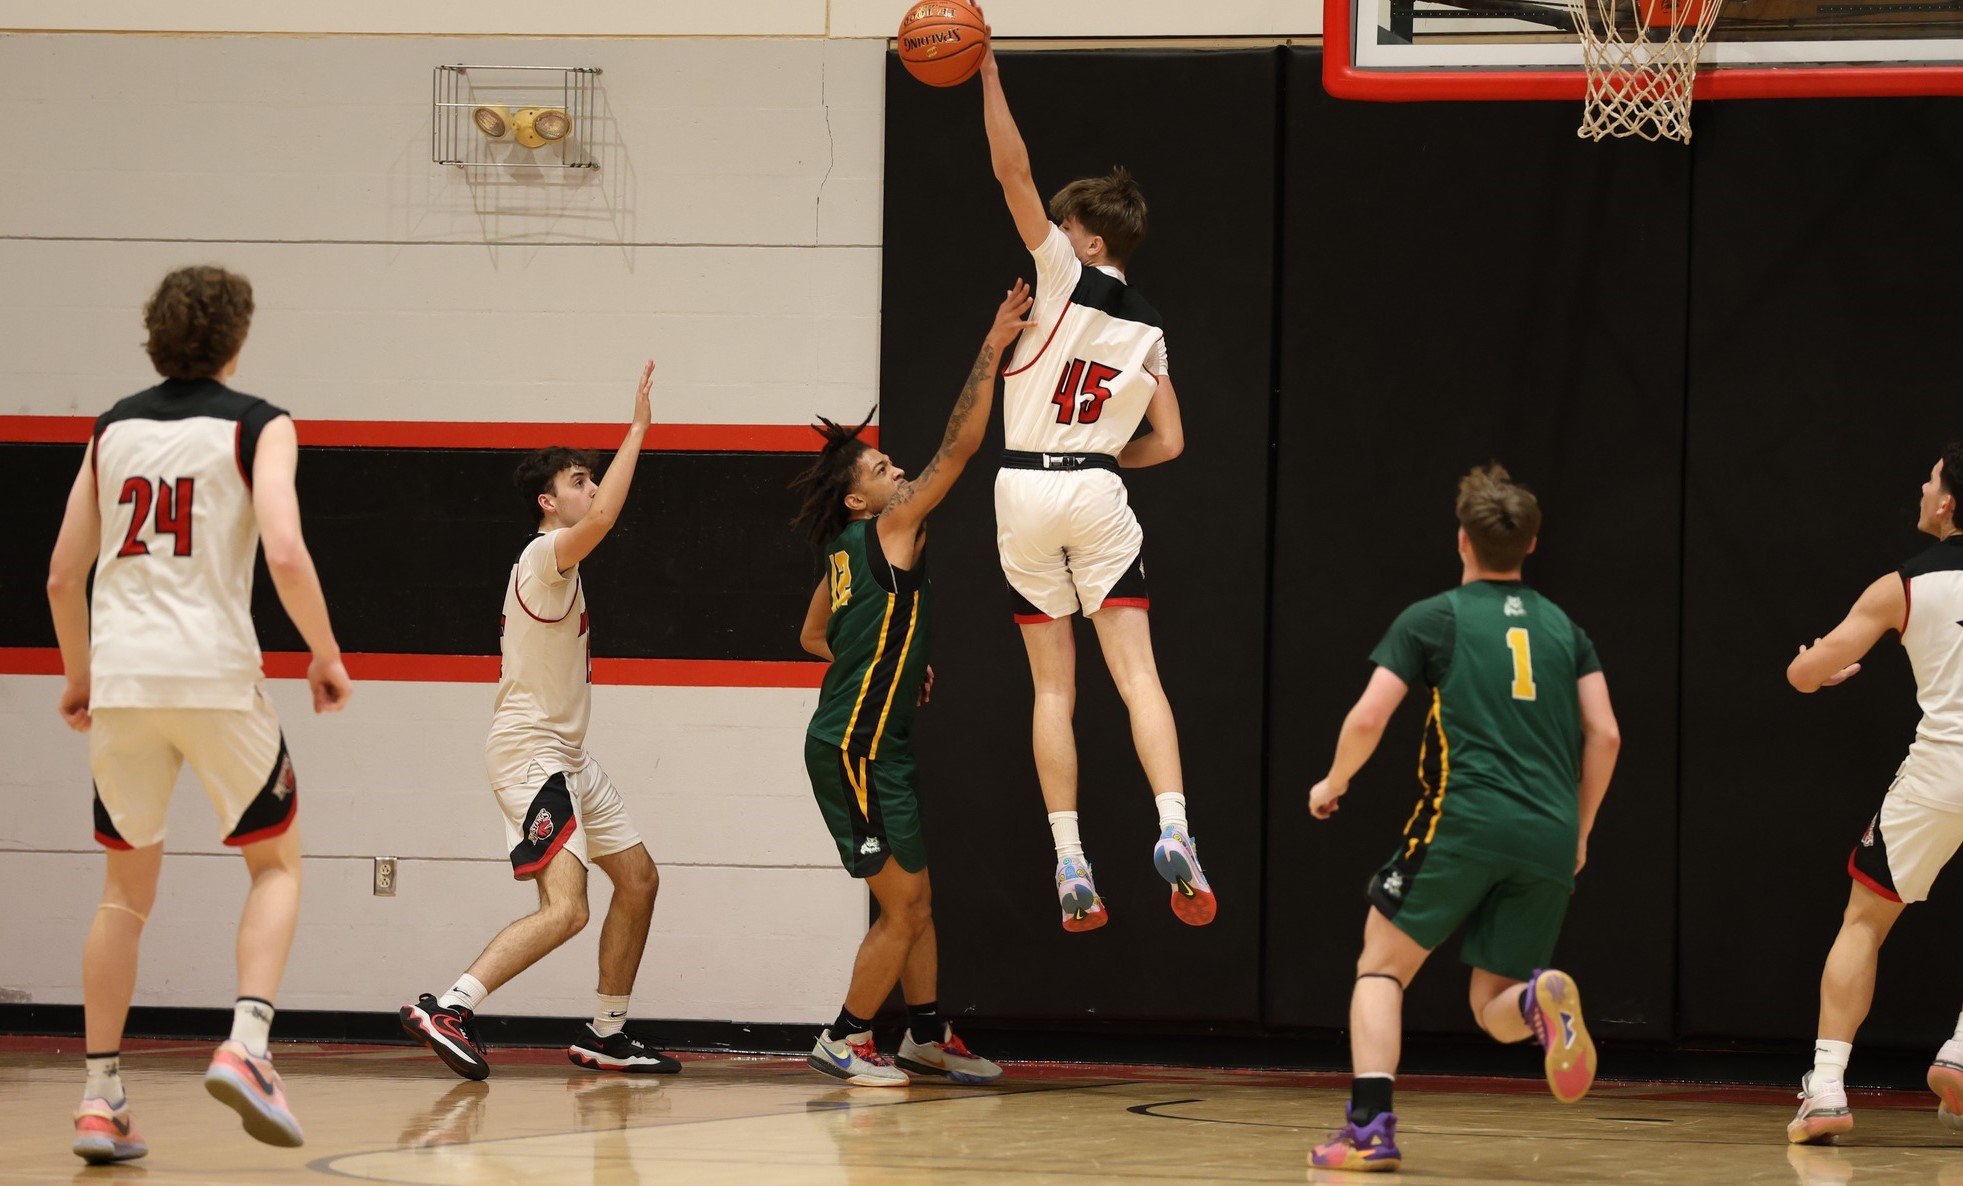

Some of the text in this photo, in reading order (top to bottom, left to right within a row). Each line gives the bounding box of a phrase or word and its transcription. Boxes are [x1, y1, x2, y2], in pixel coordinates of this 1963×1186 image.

[904, 28, 960, 51] SPALDING
[1051, 357, 1123, 425] 45
[117, 476, 194, 558] 24
[829, 550, 852, 613] 12
[1506, 627, 1536, 701] 1
